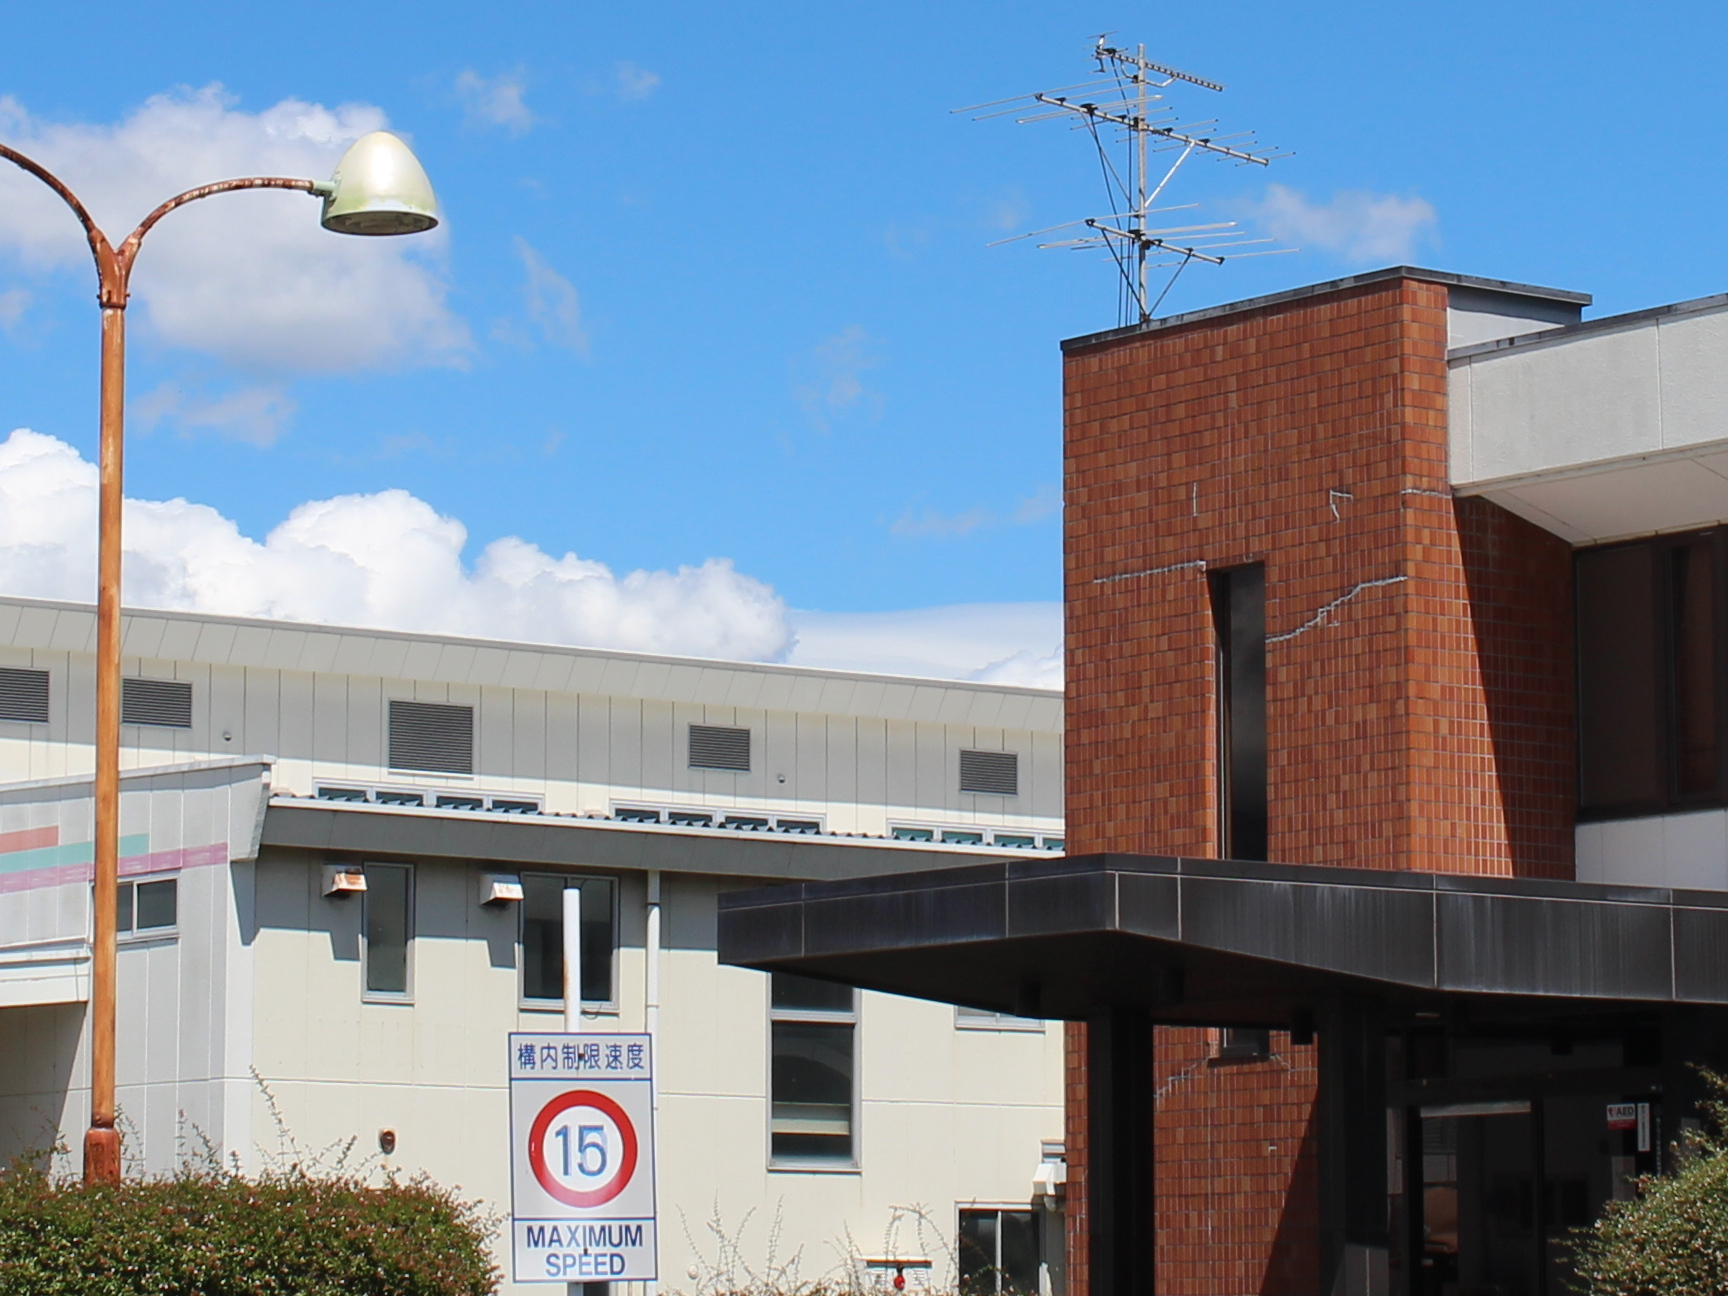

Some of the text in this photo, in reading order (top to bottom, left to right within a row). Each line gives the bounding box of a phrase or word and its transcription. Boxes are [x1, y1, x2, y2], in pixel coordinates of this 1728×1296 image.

[517, 1043, 645, 1071] 構内制限速度
[1616, 1106, 1634, 1116] AED
[554, 1124, 608, 1177] 15
[526, 1225, 644, 1249] MAXIMUM
[545, 1253, 626, 1277] SPEED
